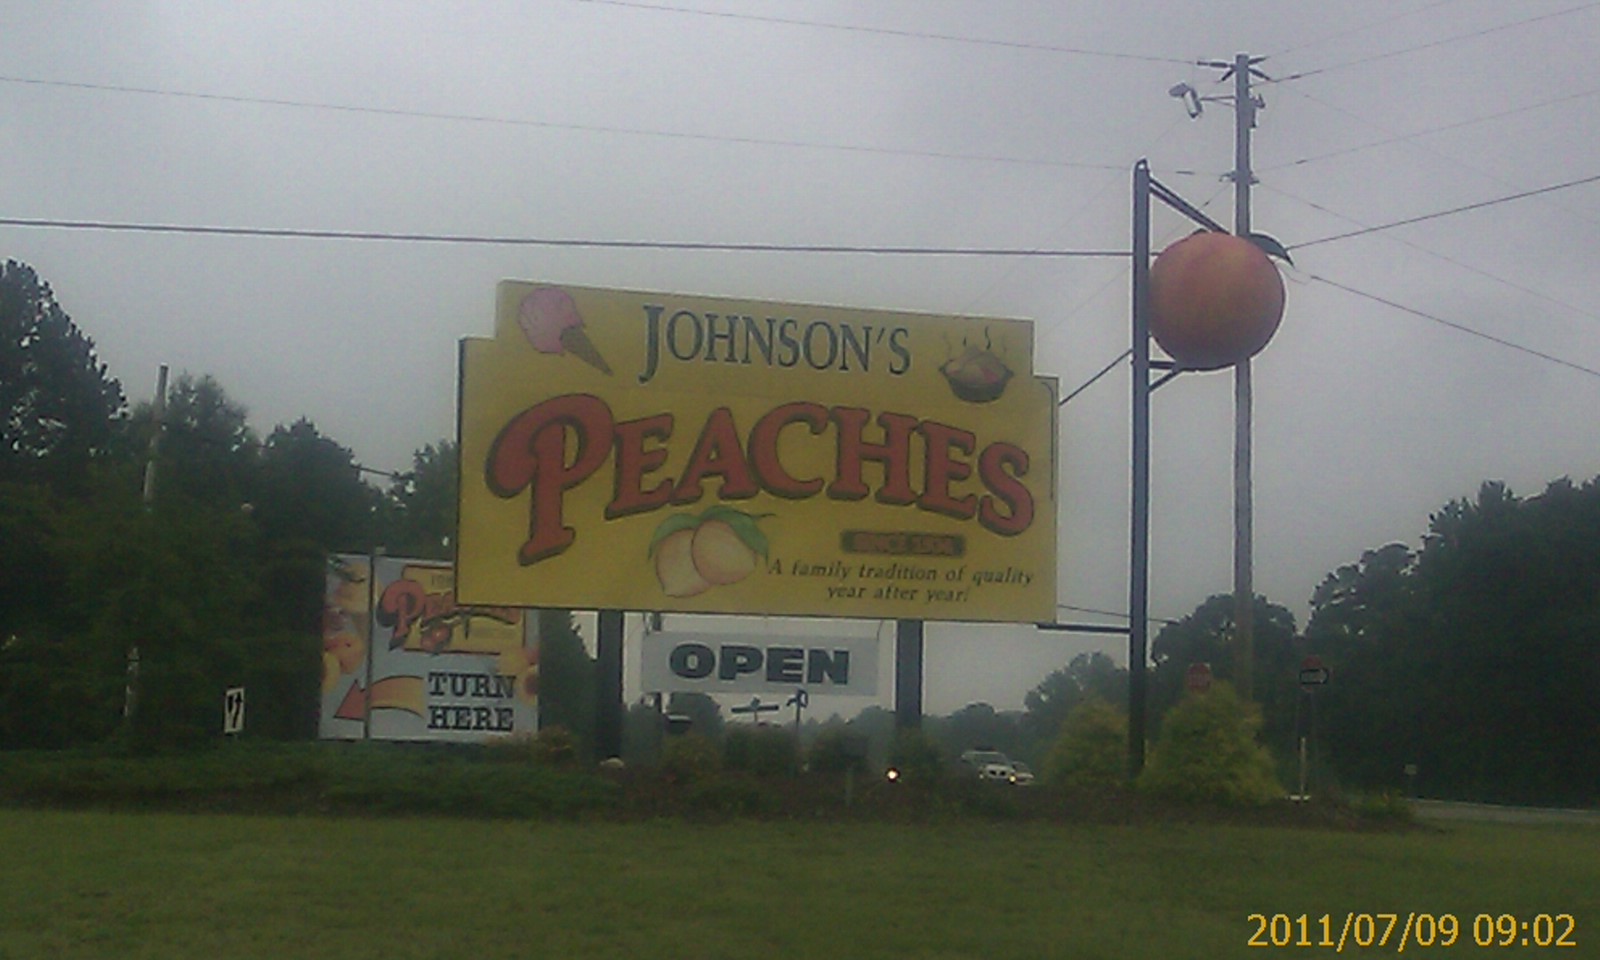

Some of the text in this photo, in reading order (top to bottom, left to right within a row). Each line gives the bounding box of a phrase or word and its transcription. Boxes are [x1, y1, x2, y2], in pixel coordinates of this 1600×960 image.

[638, 304, 911, 384] JOHNSON'S
[485, 392, 1035, 566] PEACHES
[768, 559, 1034, 588] A family tradition of quality
[827, 583, 865, 600] year
[874, 582, 918, 601] after
[669, 643, 850, 686] OPEN
[428, 672, 516, 699] TURN
[427, 705, 514, 732] HERE
